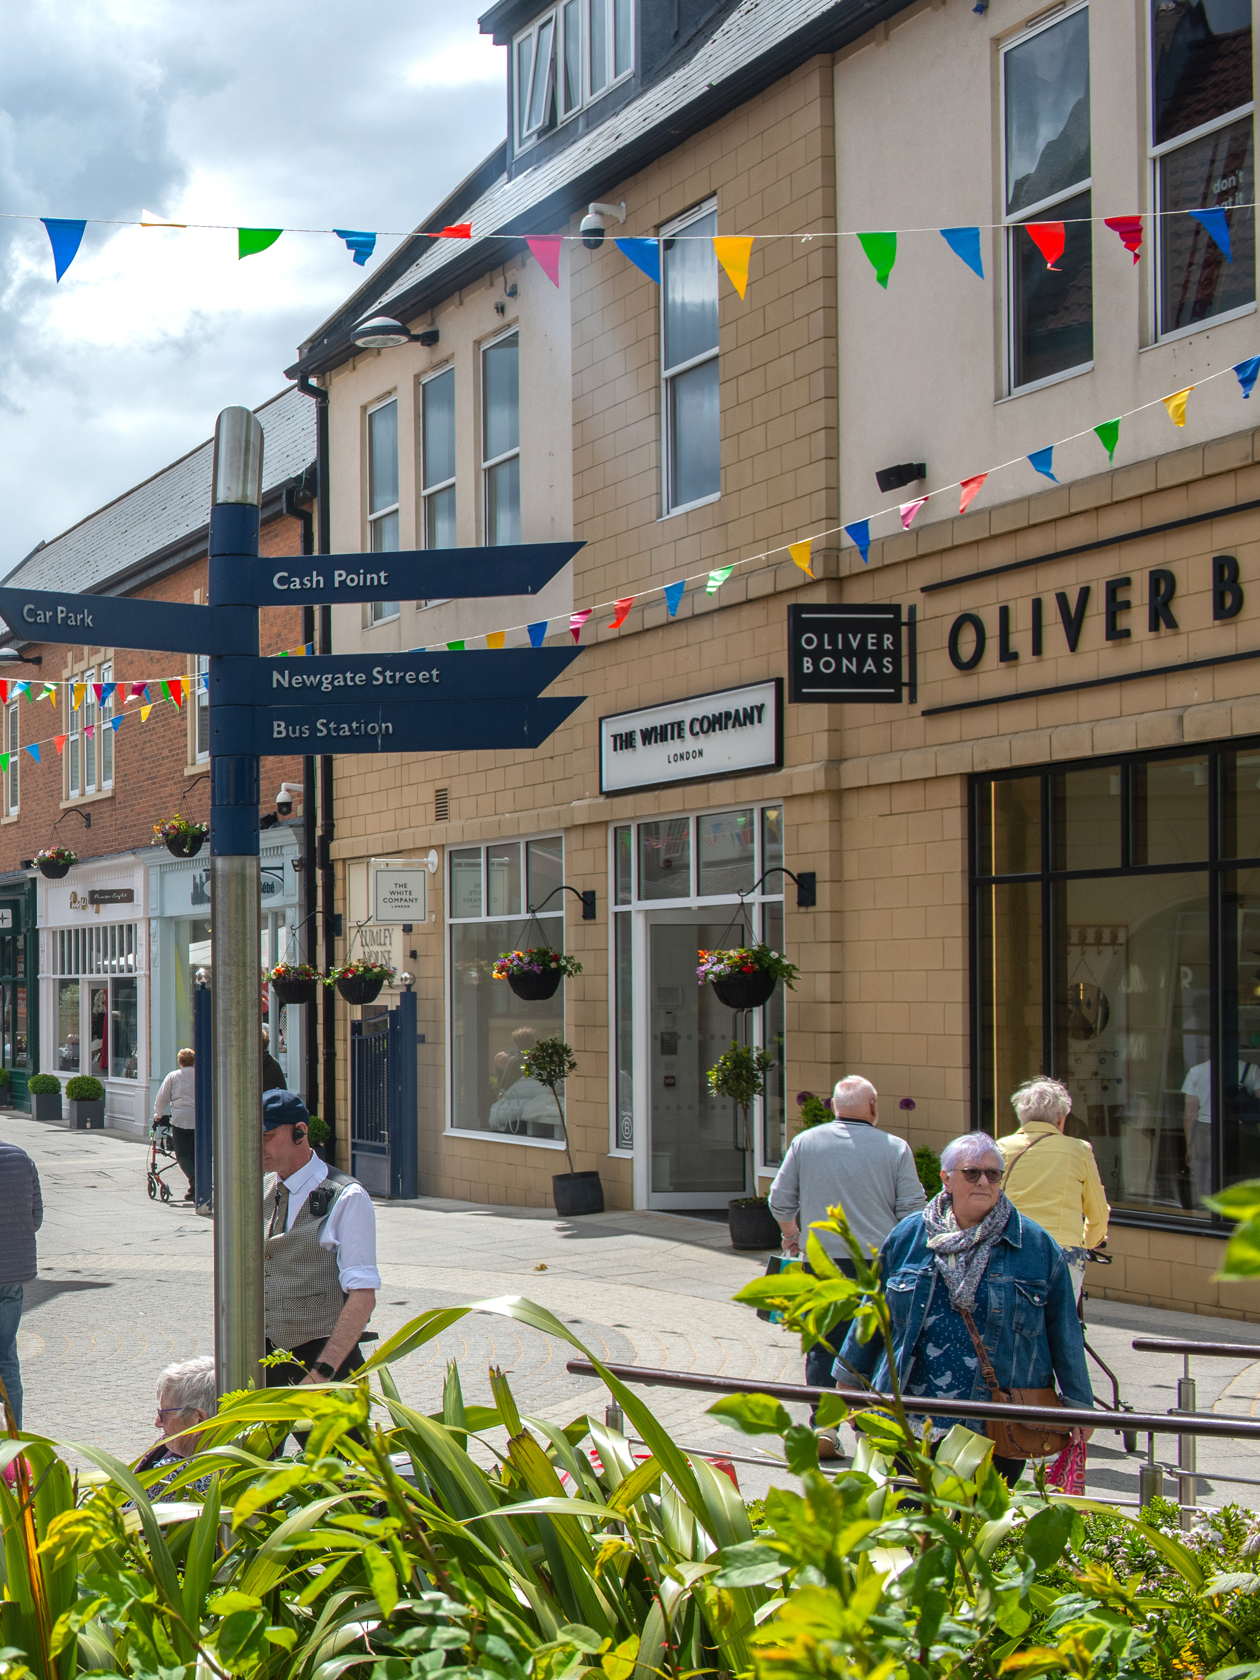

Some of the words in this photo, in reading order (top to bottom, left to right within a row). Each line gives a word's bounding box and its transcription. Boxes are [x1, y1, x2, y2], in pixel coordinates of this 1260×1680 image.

[273, 571, 324, 590] Cash
[334, 569, 389, 588] Point
[23, 604, 53, 623] Car
[57, 606, 93, 627] Park
[948, 571, 1179, 671] OLIVER
[801, 633, 894, 650] OLIVER
[803, 656, 893, 674] BONAS
[272, 670, 367, 692] Newgate
[372, 667, 440, 686] Street
[273, 720, 310, 738] Bus
[316, 718, 393, 737] Station
[611, 730, 636, 752] THE
[640, 720, 685, 746] WHITE
[689, 703, 765, 737] COMPANY
[667, 748, 704, 764] LONDON
[260, 881, 275, 893] ébé
[360, 928, 394, 946] LUMLEY
